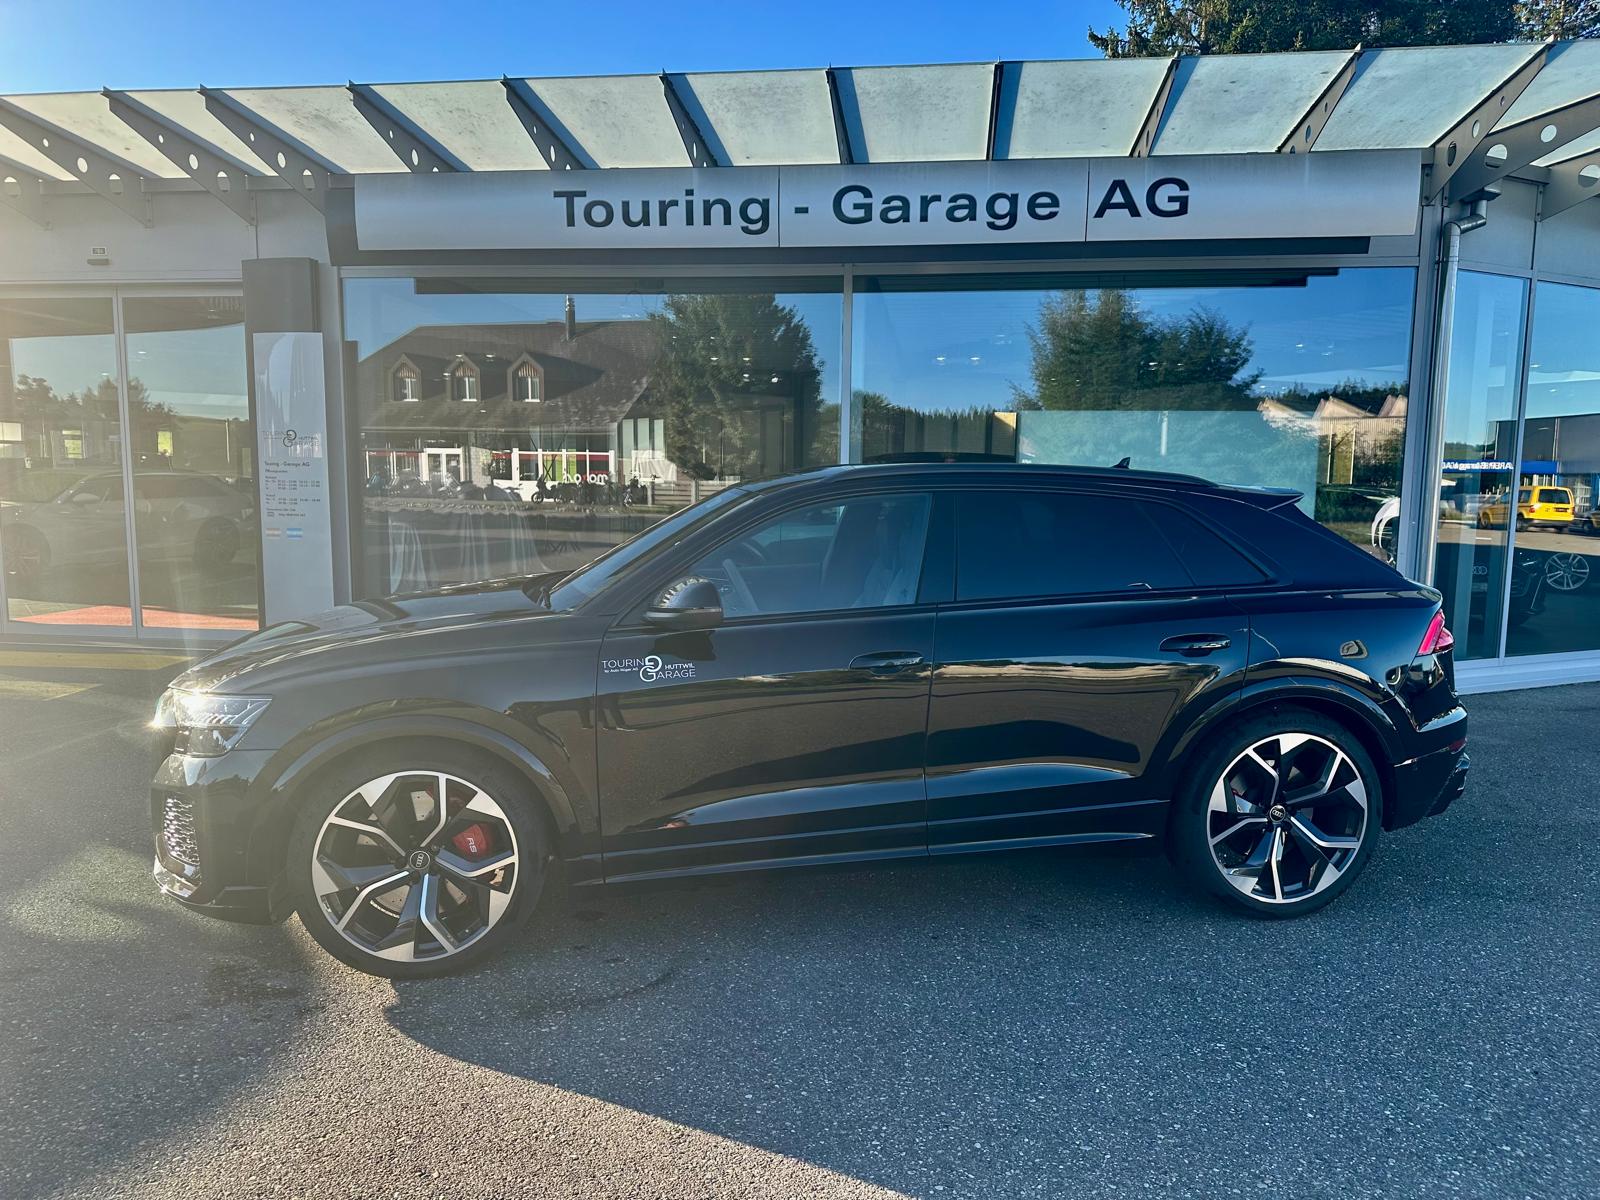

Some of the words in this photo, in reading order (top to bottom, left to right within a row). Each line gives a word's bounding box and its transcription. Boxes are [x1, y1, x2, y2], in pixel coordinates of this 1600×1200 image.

[553, 188, 770, 236] Touring
[794, 206, 809, 214] -
[832, 184, 1060, 231] Garage
[1093, 176, 1190, 218] AG
[639, 665, 696, 682] GARAGE
[664, 662, 695, 670] HUTTWIL
[466, 837, 478, 853] RS
